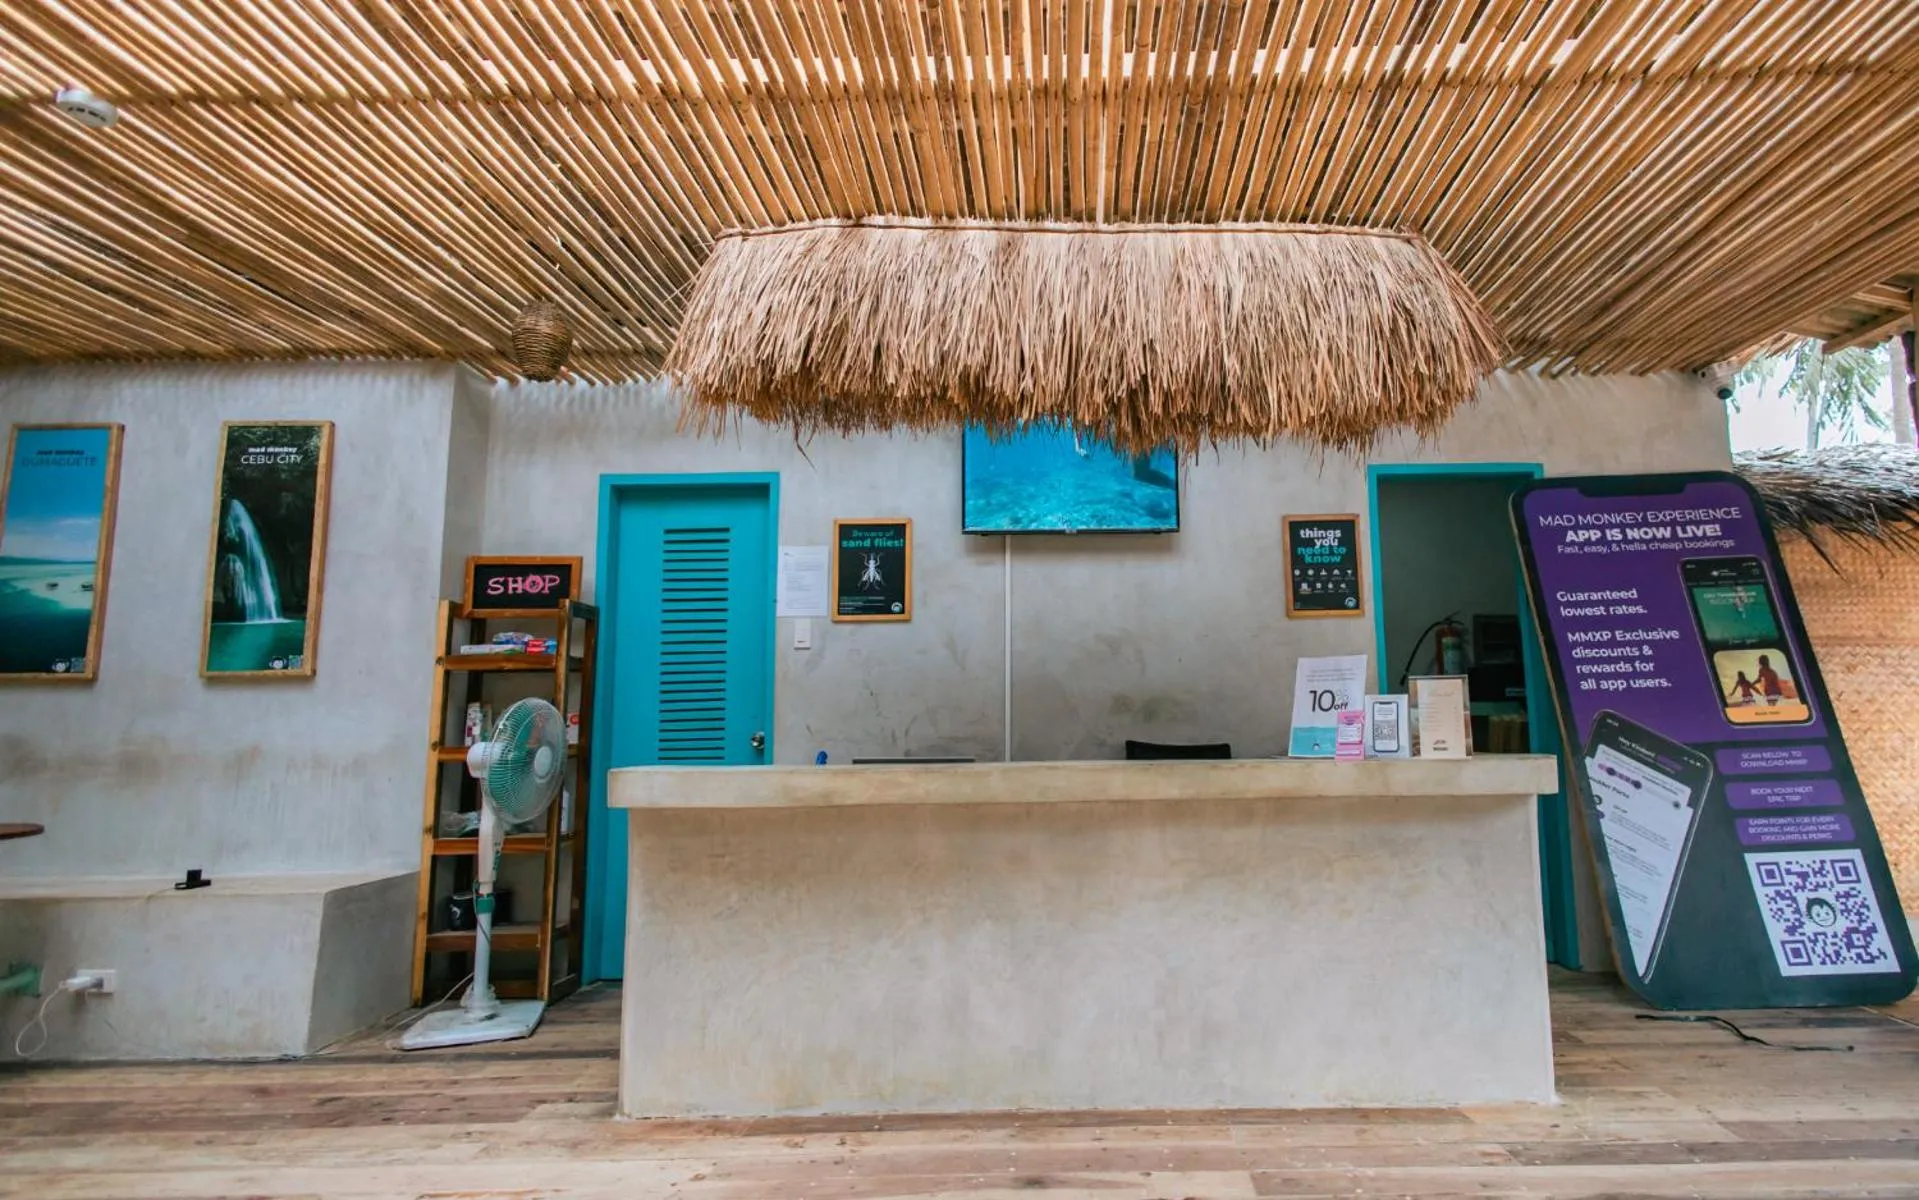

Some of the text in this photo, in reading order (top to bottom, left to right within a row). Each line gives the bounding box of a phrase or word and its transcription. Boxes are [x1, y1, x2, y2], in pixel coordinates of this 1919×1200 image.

[241, 454, 304, 465] CEBU CITY
[1539, 506, 1742, 527] MAD MONKEY EXPERIENCE
[1299, 527, 1342, 539] things
[1565, 523, 1723, 542] APP IS NOW LIVE!
[841, 537, 904, 548] sand flies!
[1314, 537, 1339, 548] you
[1557, 538, 1736, 555] Fast, easy, & hella cheap bookings
[1297, 546, 1347, 555] need to
[1304, 554, 1342, 563] know
[486, 573, 561, 595] SHOP
[1556, 588, 1638, 602] Guaranteed
[1560, 604, 1648, 617] lowest rates.
[1567, 628, 1680, 642] MMXP Exclusive
[1571, 645, 1653, 658] discounts &
[1575, 660, 1655, 674] rewards for
[1580, 678, 1672, 692] all app users.
[1334, 702, 1349, 710] off
